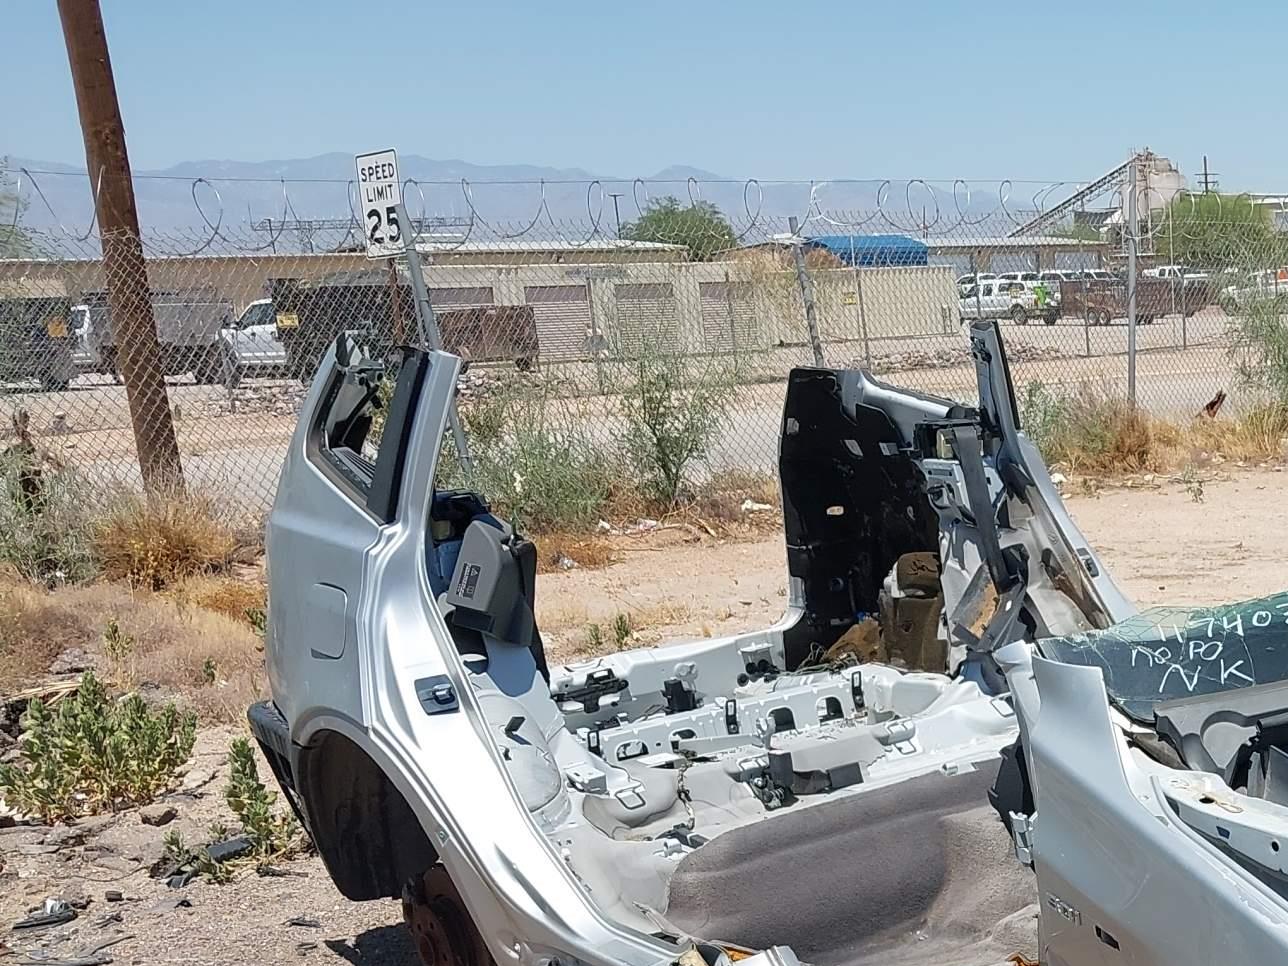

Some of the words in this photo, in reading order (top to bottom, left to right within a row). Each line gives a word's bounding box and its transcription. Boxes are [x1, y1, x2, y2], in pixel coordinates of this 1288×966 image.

[361, 163, 395, 182] SPEED
[366, 184, 394, 202] LIMIT
[367, 206, 401, 244] 25
